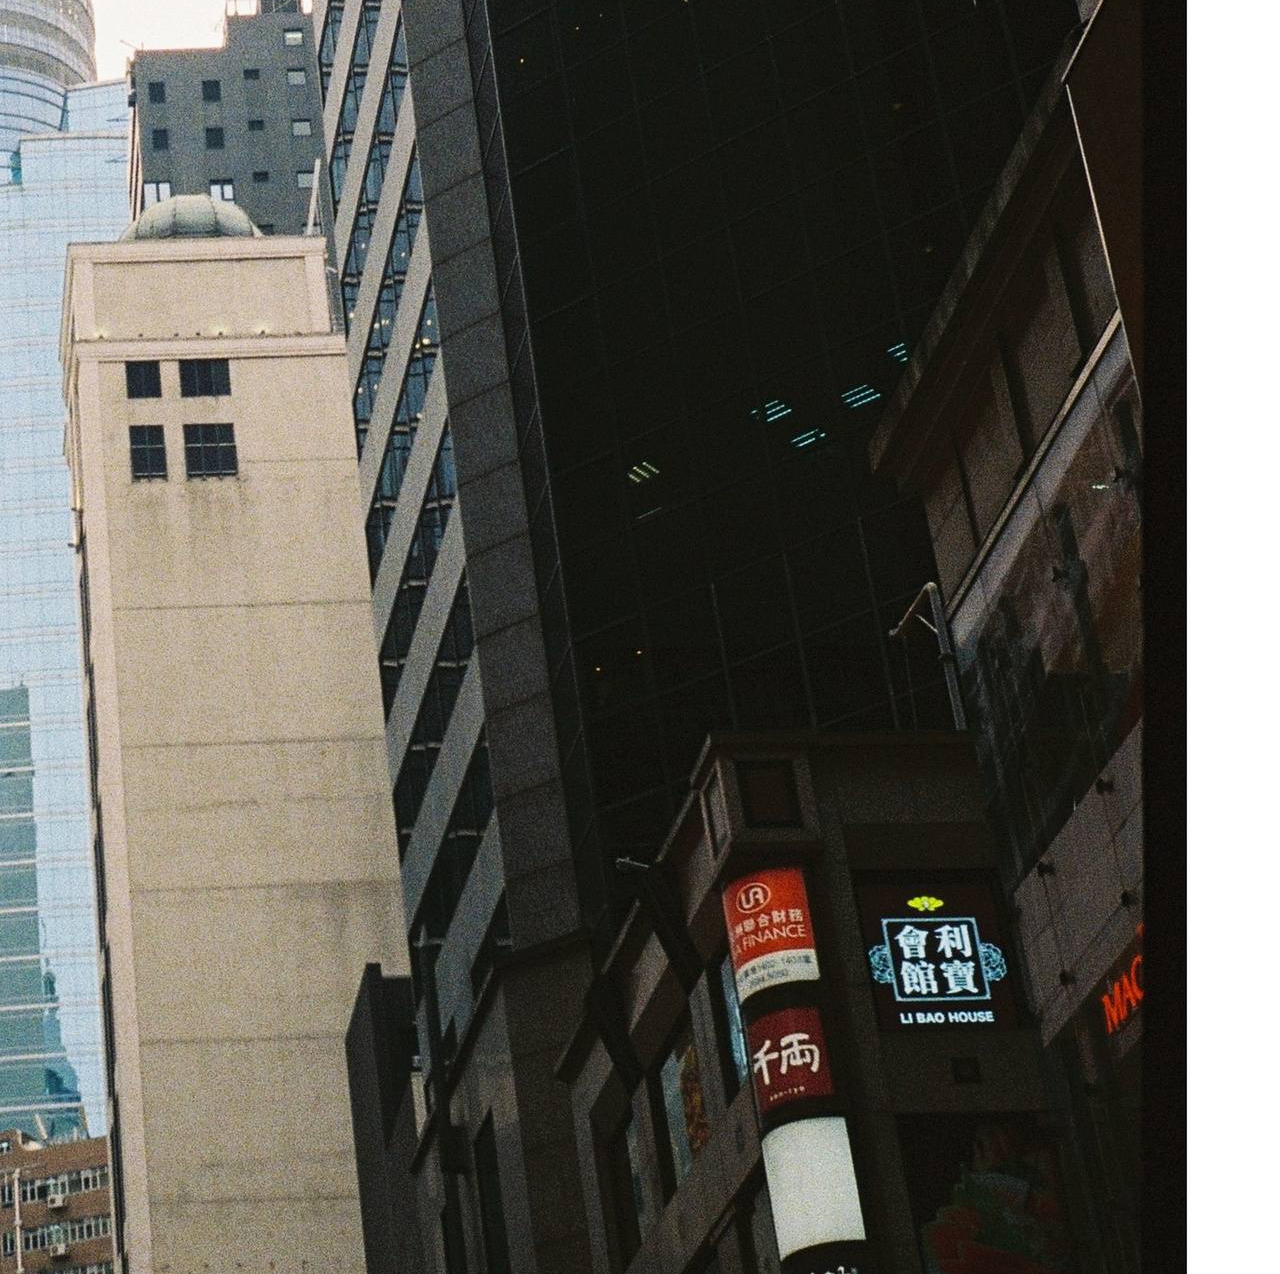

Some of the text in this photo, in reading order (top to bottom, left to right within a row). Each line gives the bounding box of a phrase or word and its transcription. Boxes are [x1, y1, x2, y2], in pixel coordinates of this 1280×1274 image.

[742, 925, 807, 951] FINANCE
[900, 1011, 995, 1024] LI BAO HOUSE
